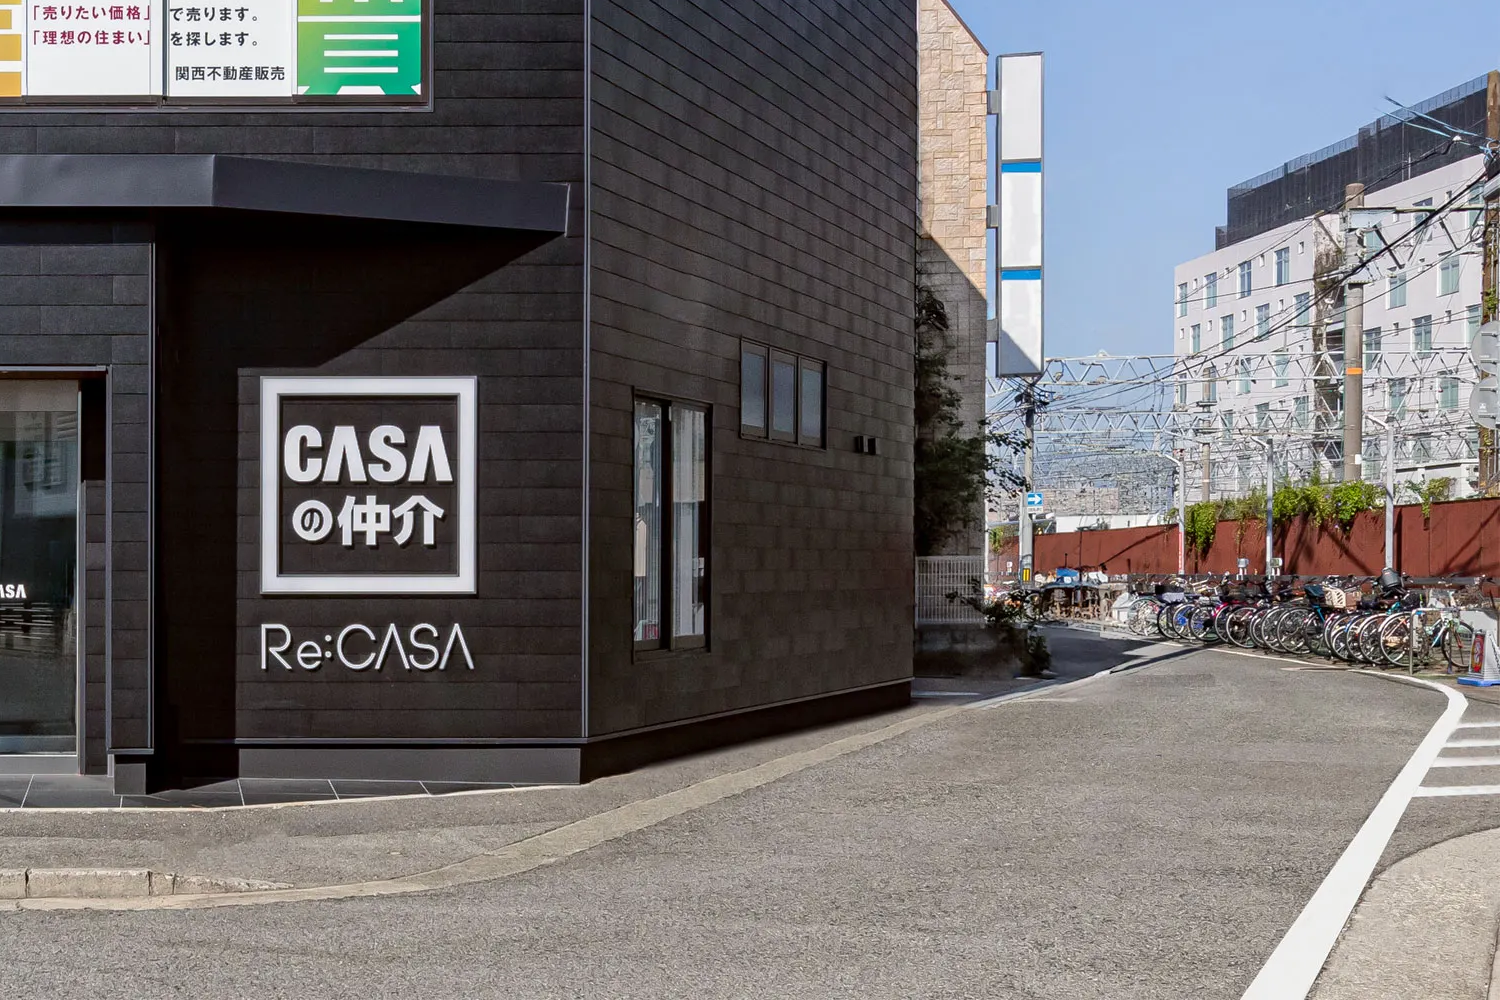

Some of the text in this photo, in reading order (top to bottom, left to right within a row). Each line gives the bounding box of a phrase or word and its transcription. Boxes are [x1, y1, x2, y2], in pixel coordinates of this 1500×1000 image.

[175, 66, 285, 82] 関西不動産販売
[284, 425, 453, 483] CASA
[292, 495, 445, 546] の仲介
[261, 622, 475, 671] Re:CASA
